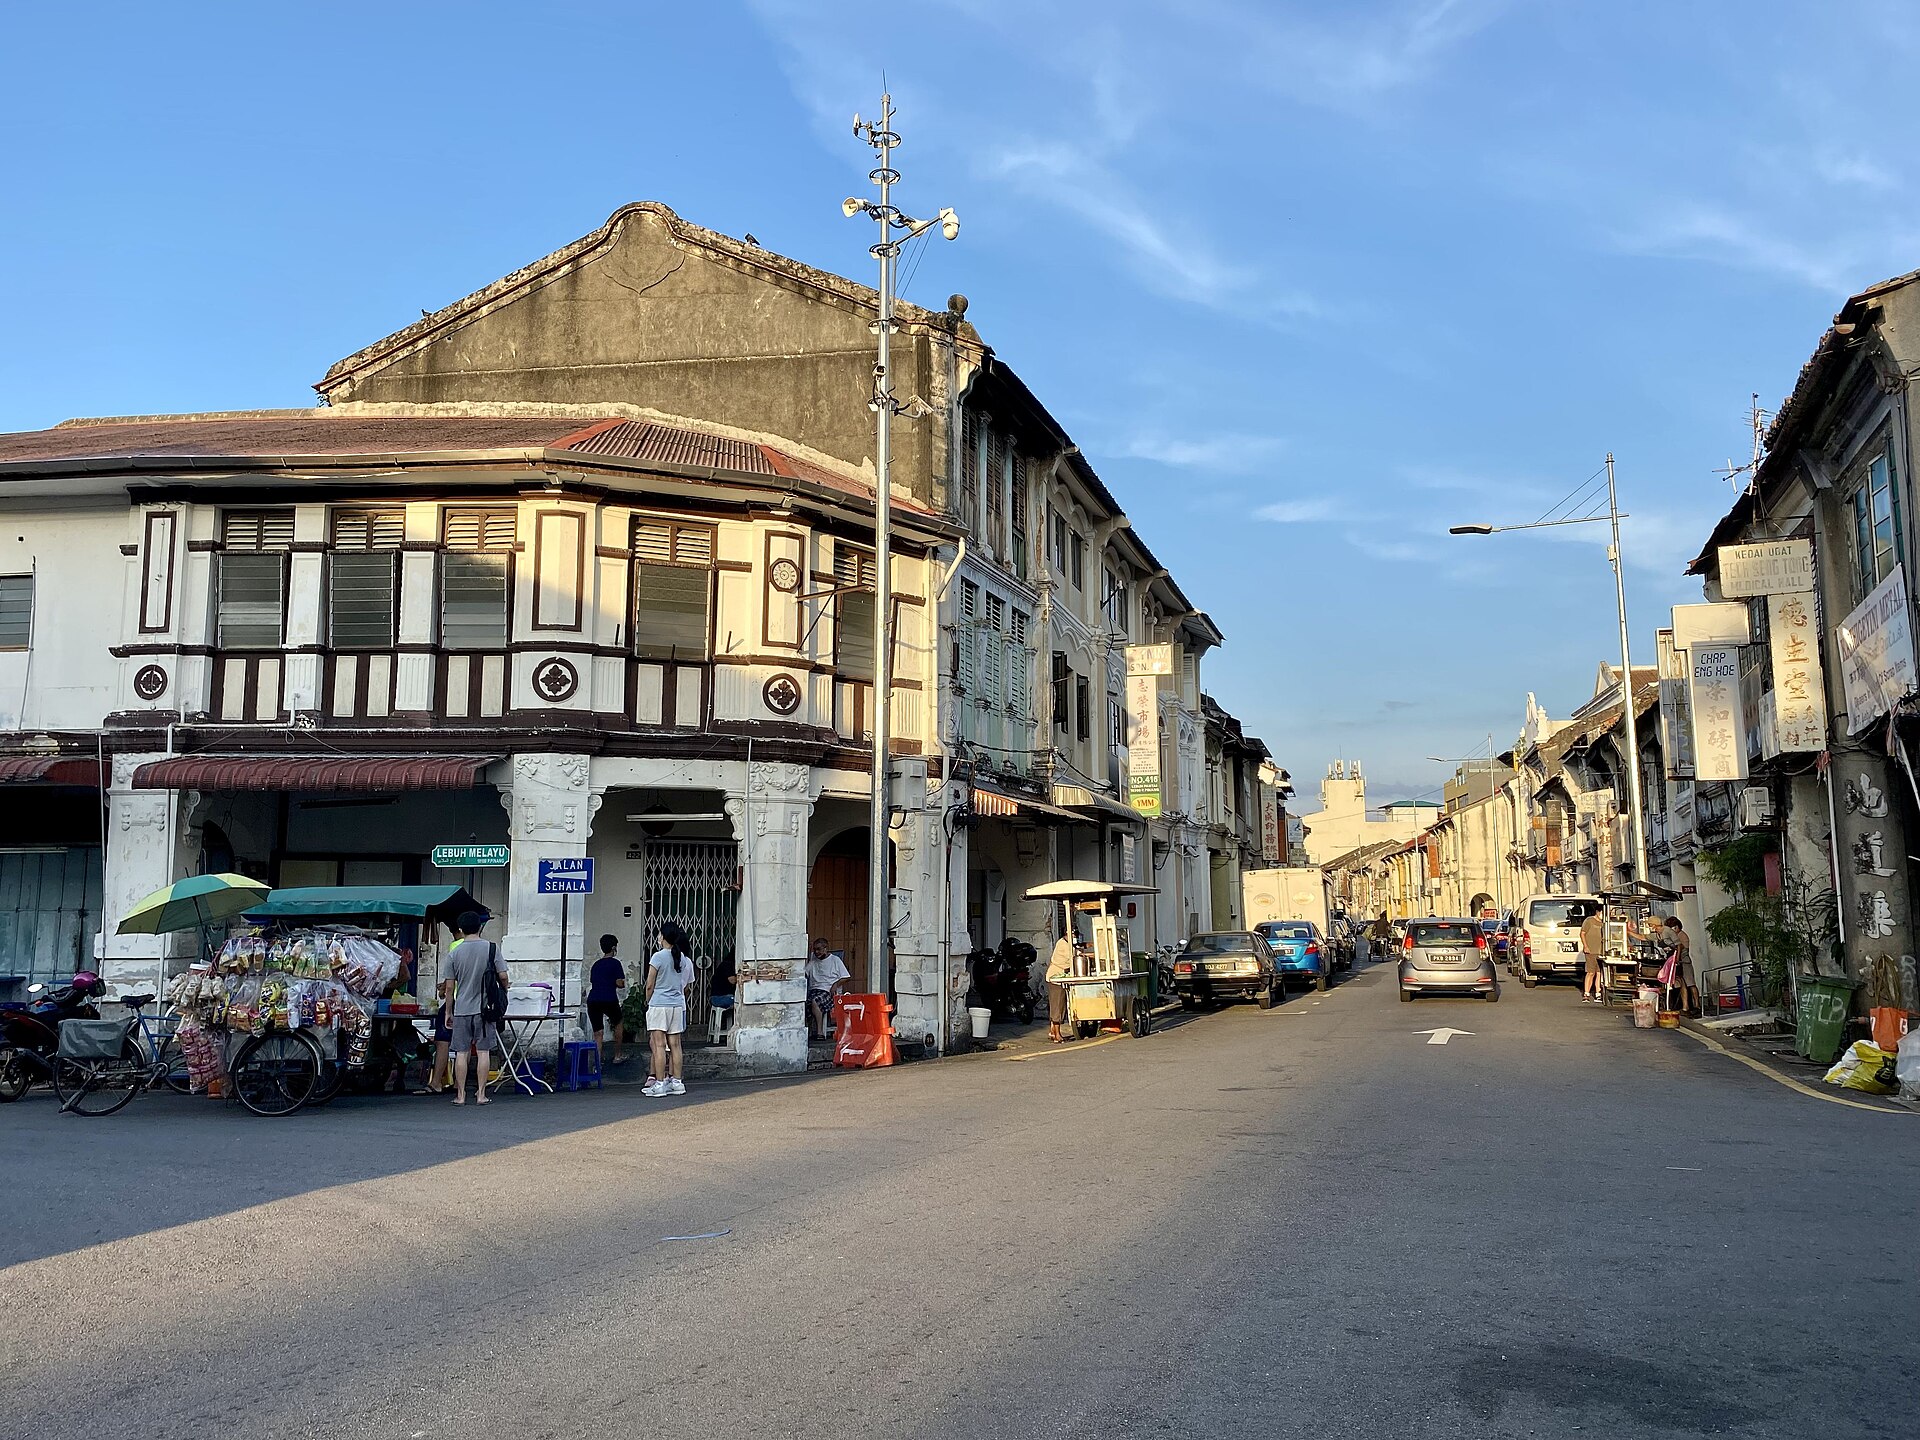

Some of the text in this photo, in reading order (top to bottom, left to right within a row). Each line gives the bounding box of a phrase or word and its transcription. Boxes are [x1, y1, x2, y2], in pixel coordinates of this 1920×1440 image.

[1701, 652, 1726, 664] CHAP
[1694, 664, 1735, 678] ENG HOE
[436, 848, 505, 858] LEBUH MELAYU
[550, 860, 583, 870] JALAN
[545, 882, 586, 891] SEHALA
